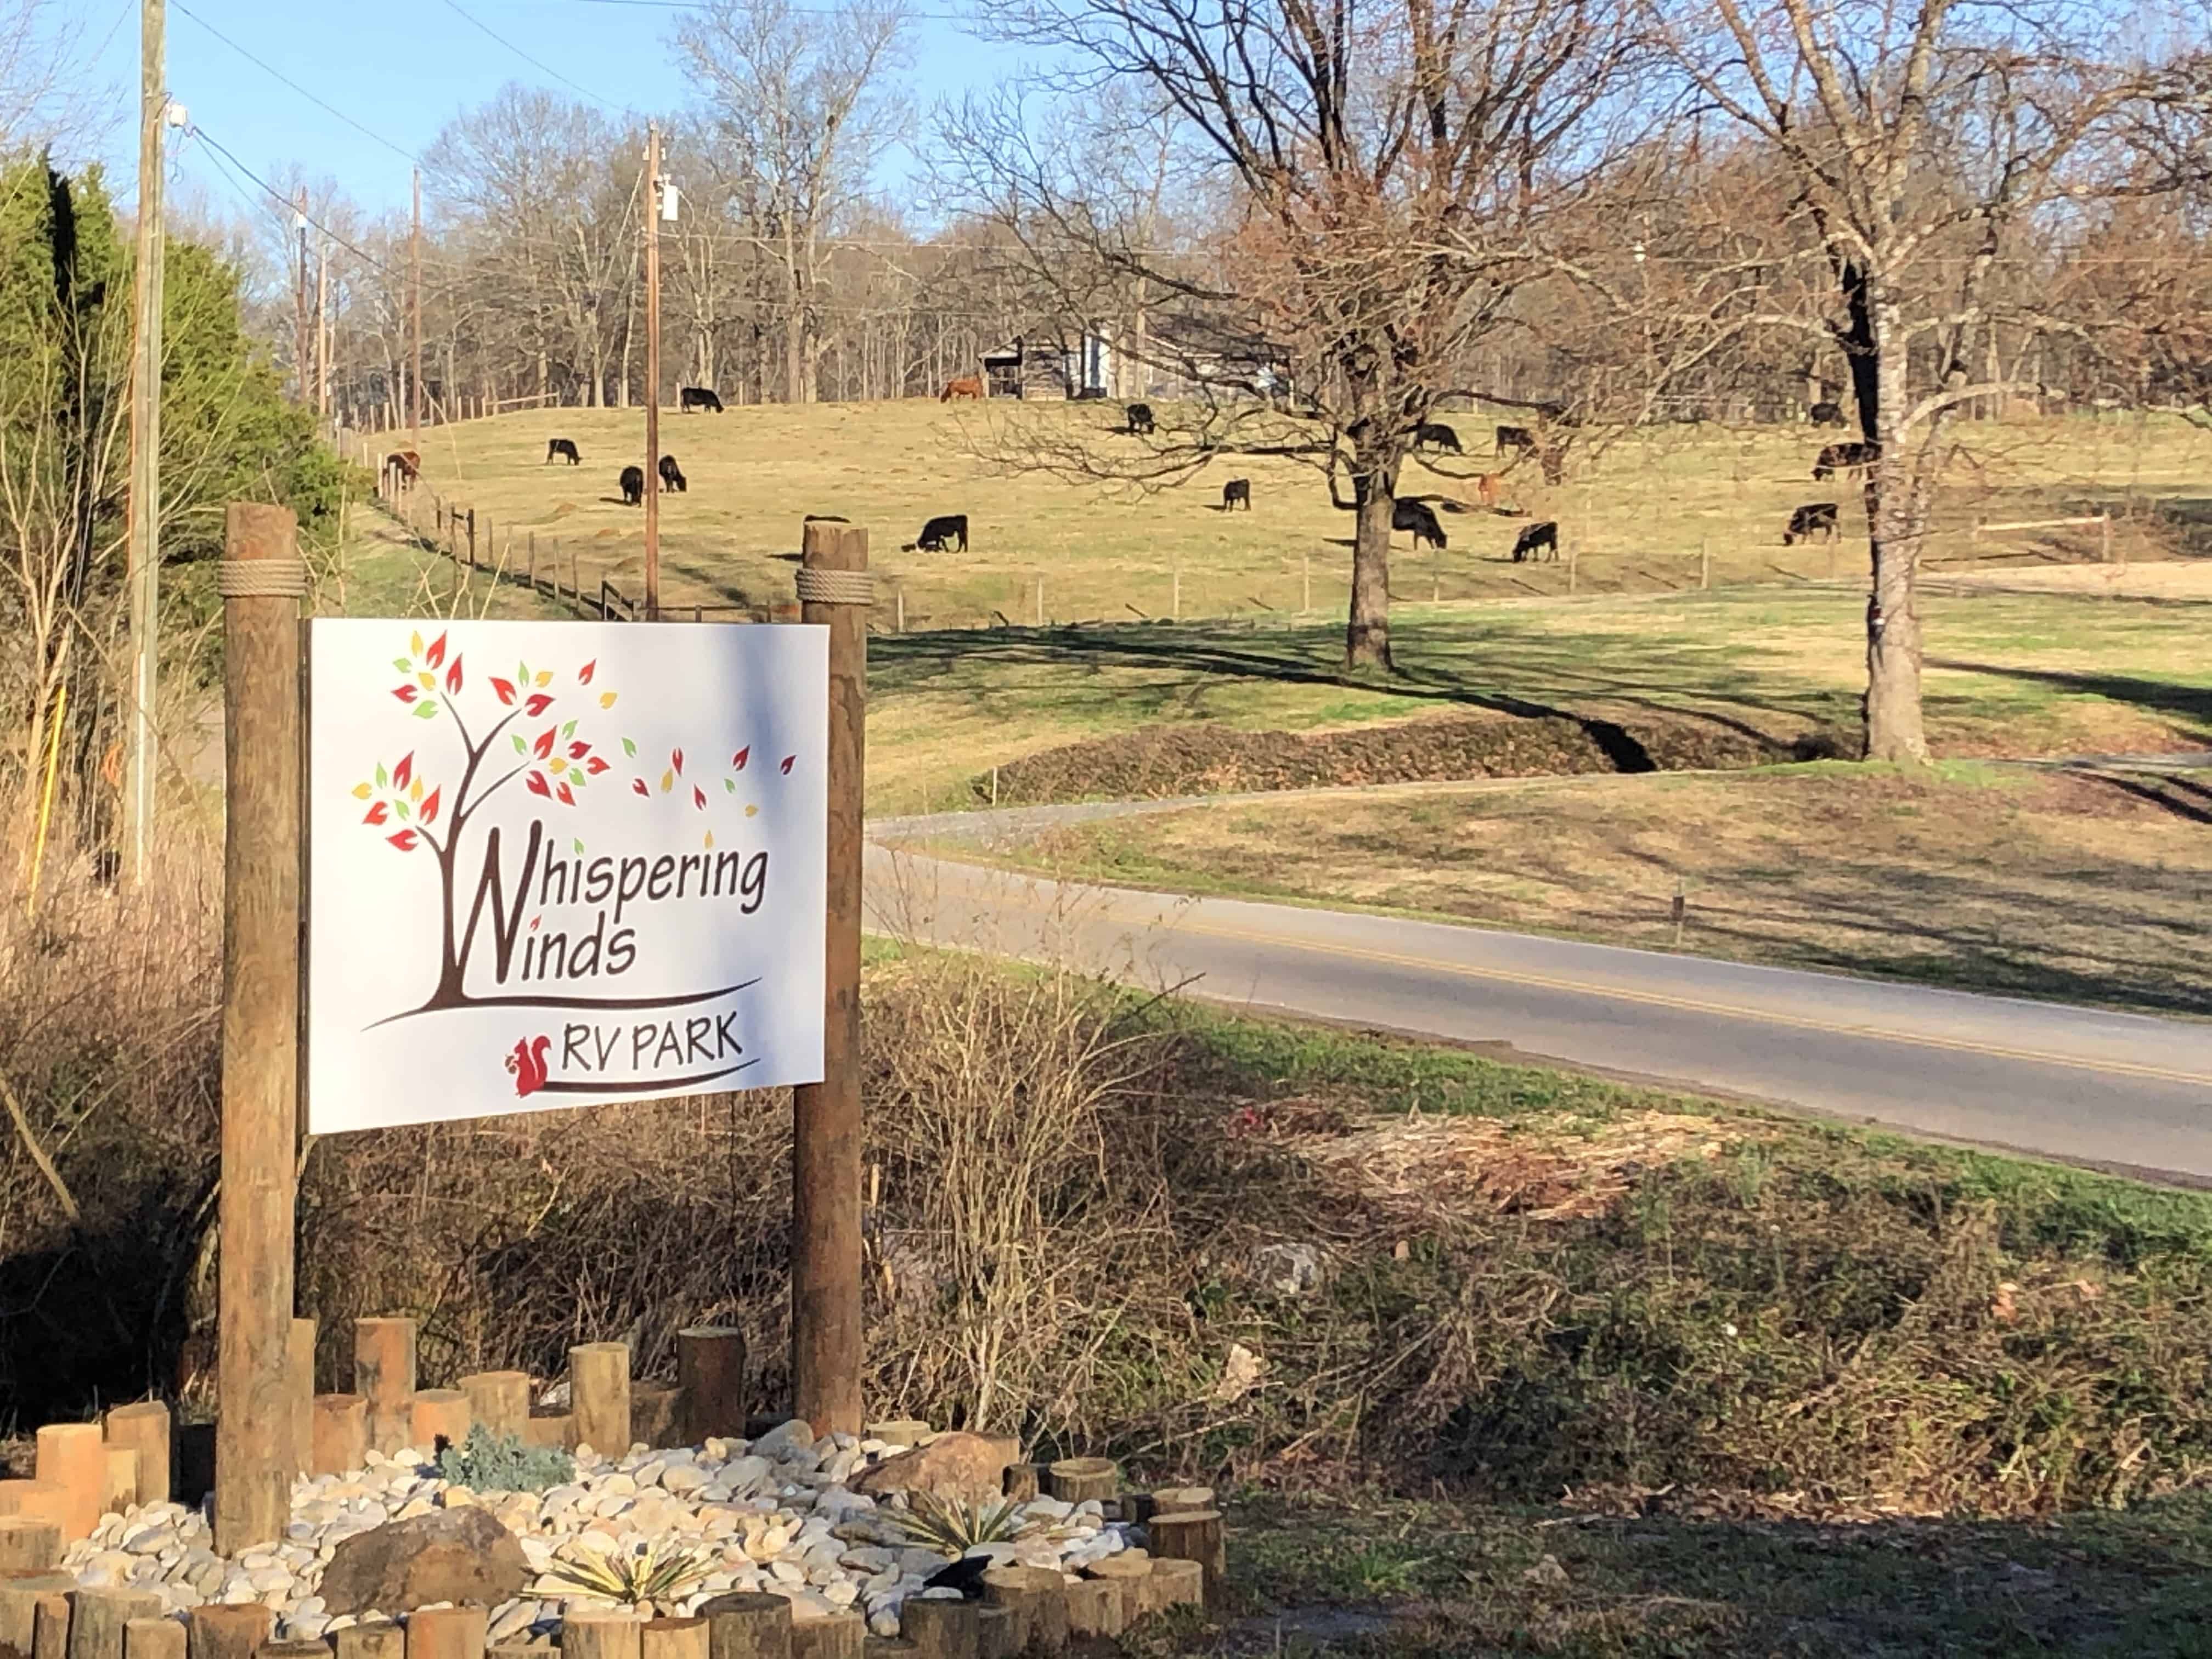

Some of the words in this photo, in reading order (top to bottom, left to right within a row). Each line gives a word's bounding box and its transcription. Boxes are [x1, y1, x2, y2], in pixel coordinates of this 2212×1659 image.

[455, 820, 769, 949] Whispering
[562, 1023, 622, 1071] RV
[632, 1011, 743, 1070] PARK
